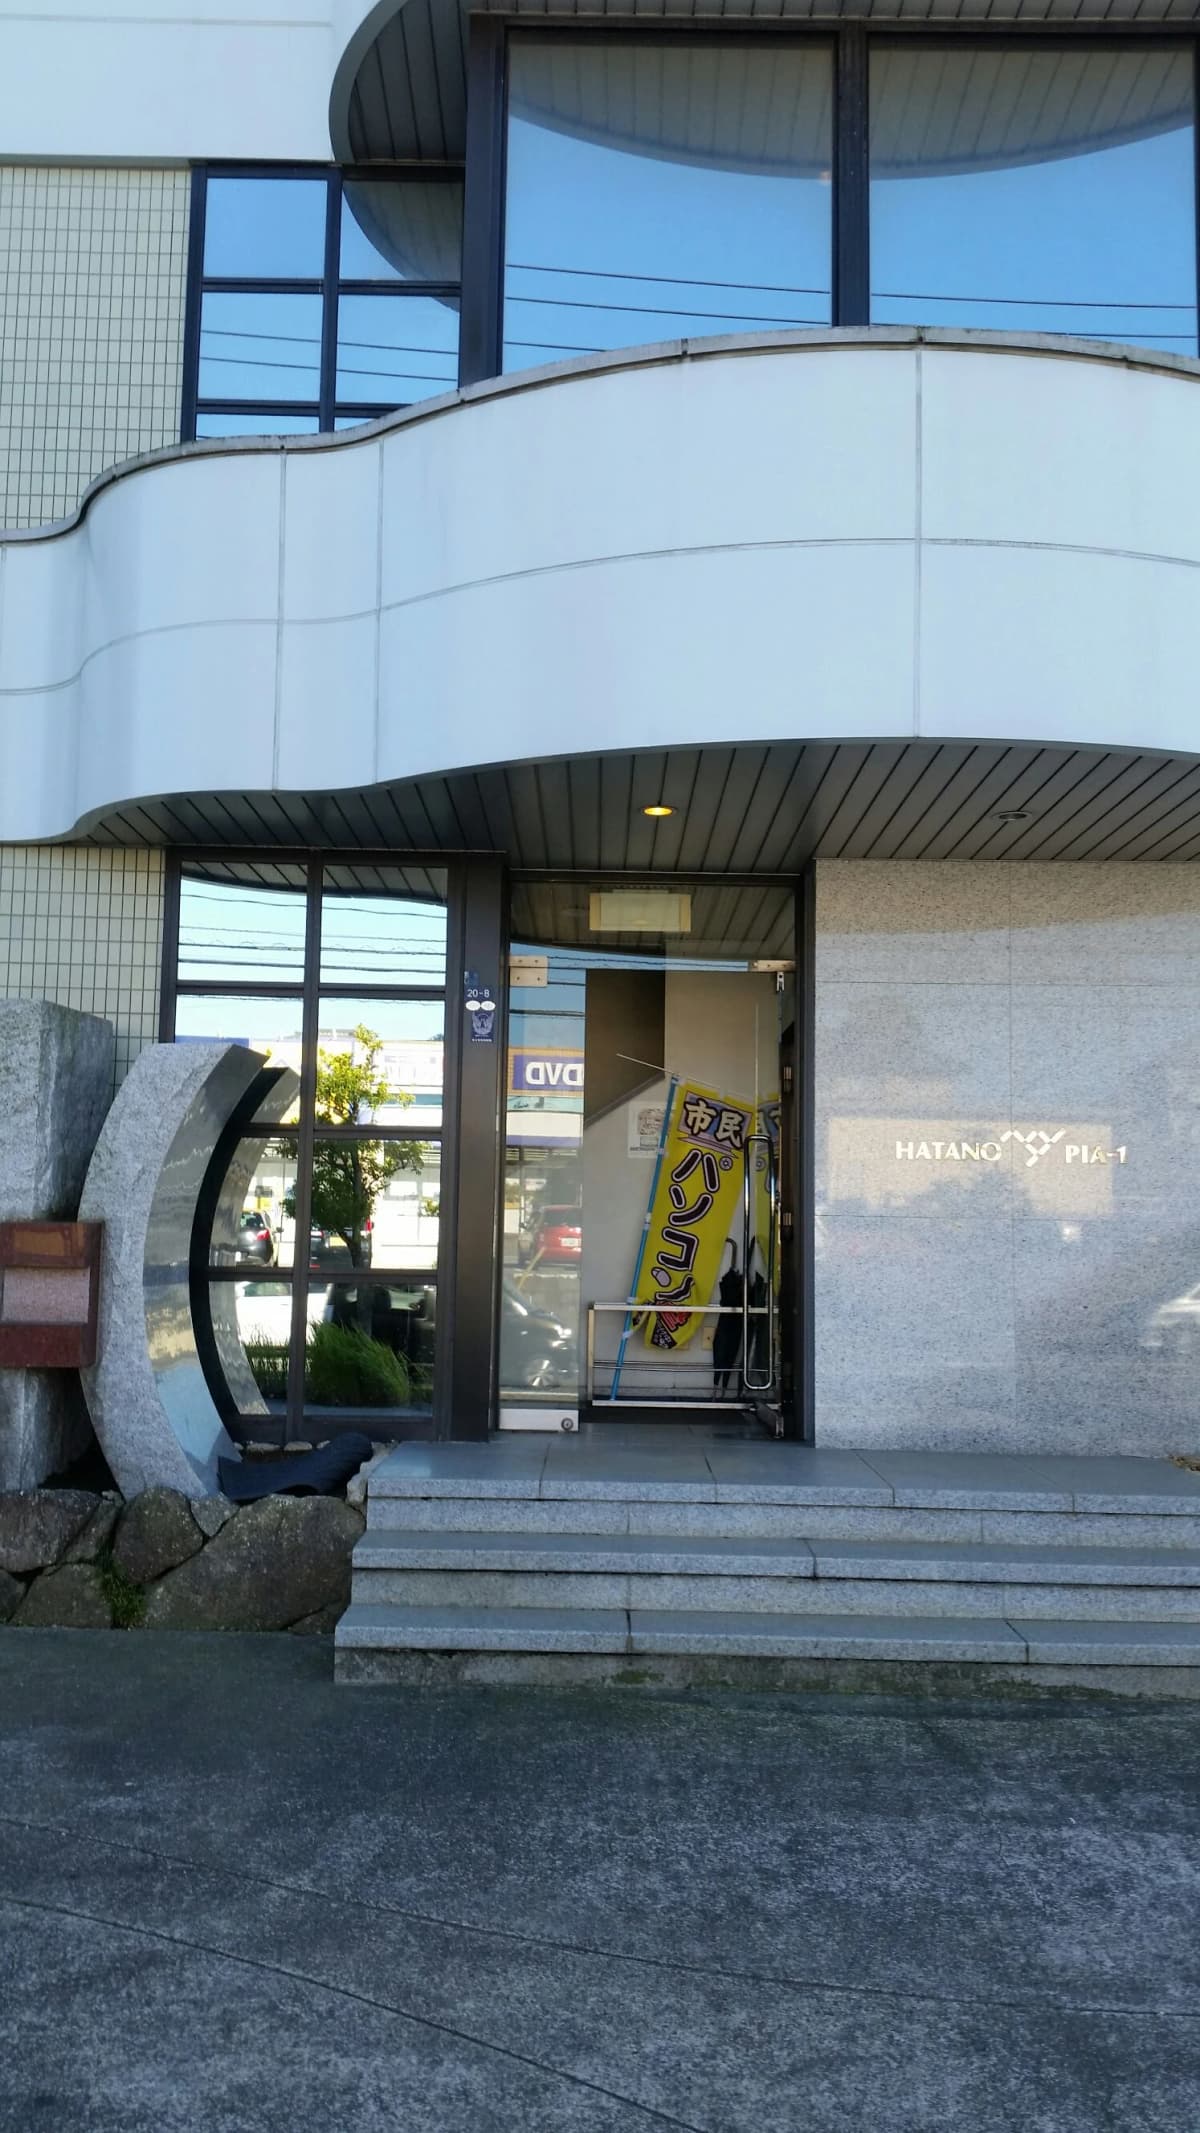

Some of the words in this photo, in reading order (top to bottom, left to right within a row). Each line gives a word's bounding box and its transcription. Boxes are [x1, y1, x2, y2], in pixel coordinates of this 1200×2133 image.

[466, 988, 490, 998] 20-8
[683, 1098, 744, 1150] 市民
[895, 1141, 1001, 1161] HATANO
[1065, 1145, 1128, 1164] PIA-1
